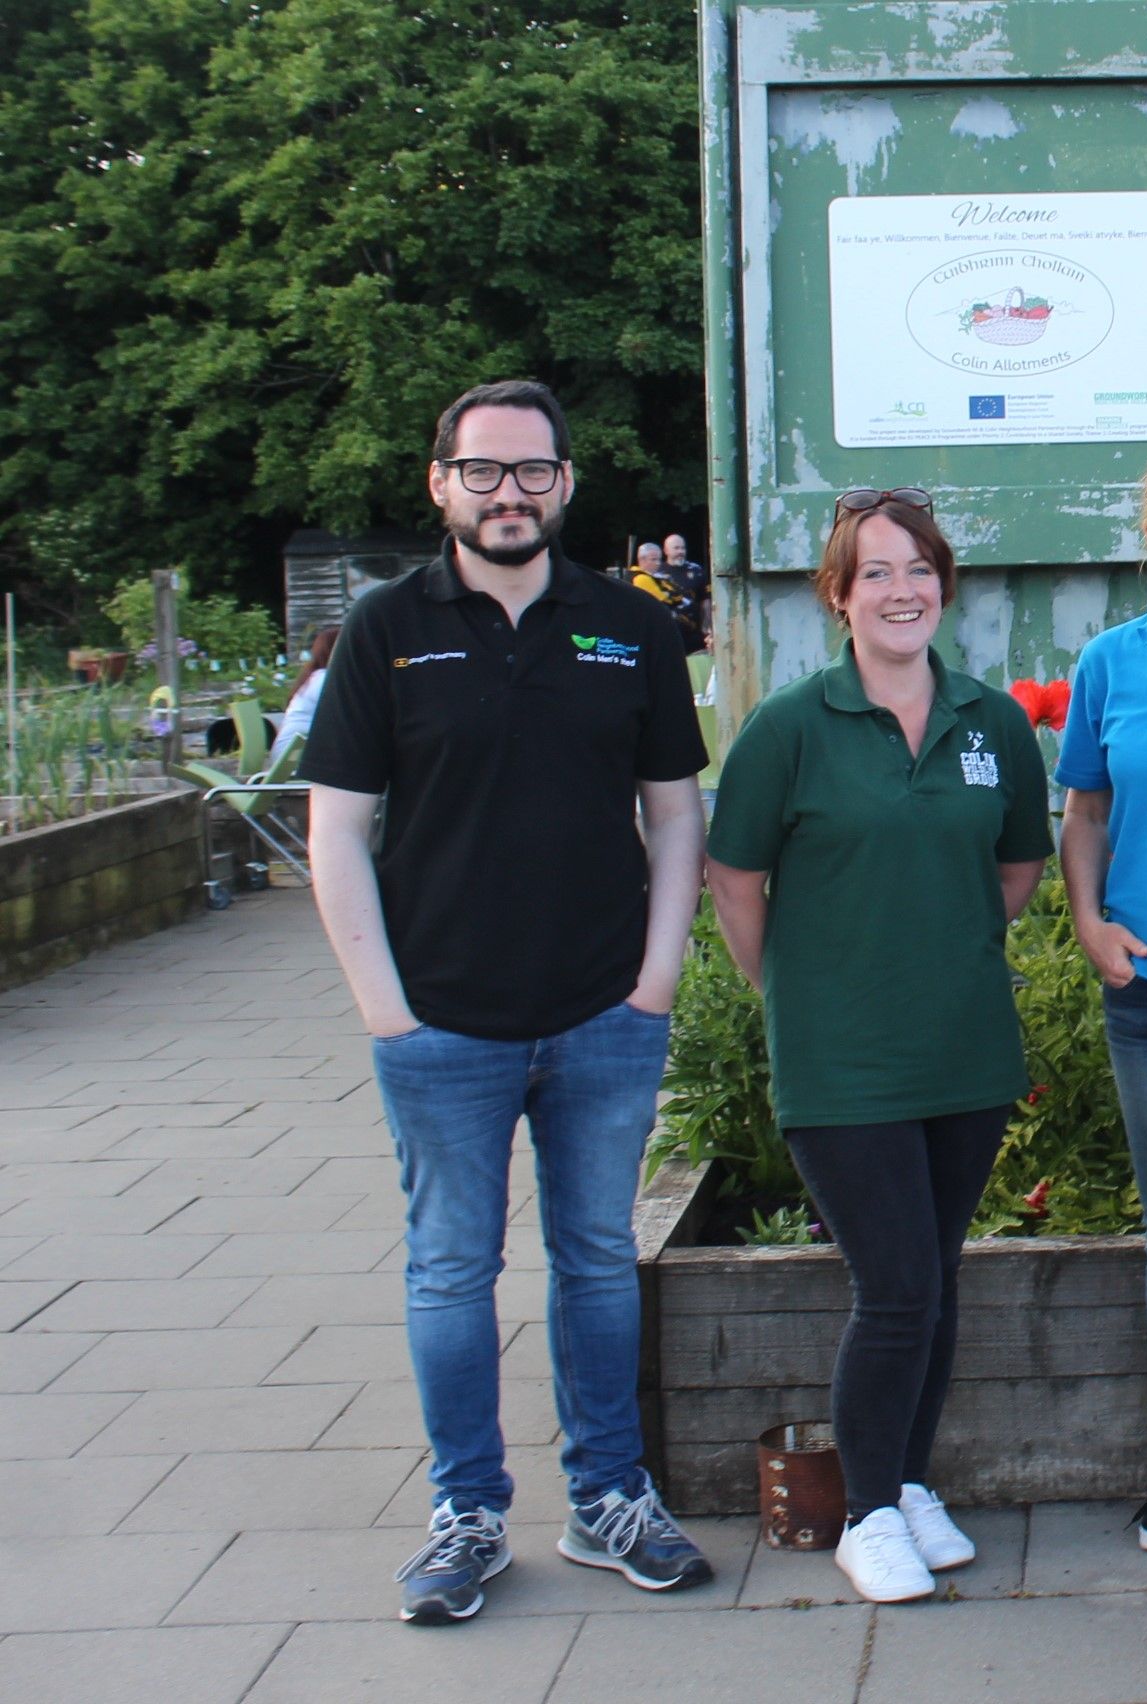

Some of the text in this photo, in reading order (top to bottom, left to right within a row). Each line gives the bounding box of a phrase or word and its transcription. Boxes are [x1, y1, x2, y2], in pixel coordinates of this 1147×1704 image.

[951, 201, 1058, 227] Welcome
[951, 350, 1071, 371] Colin Allotments
